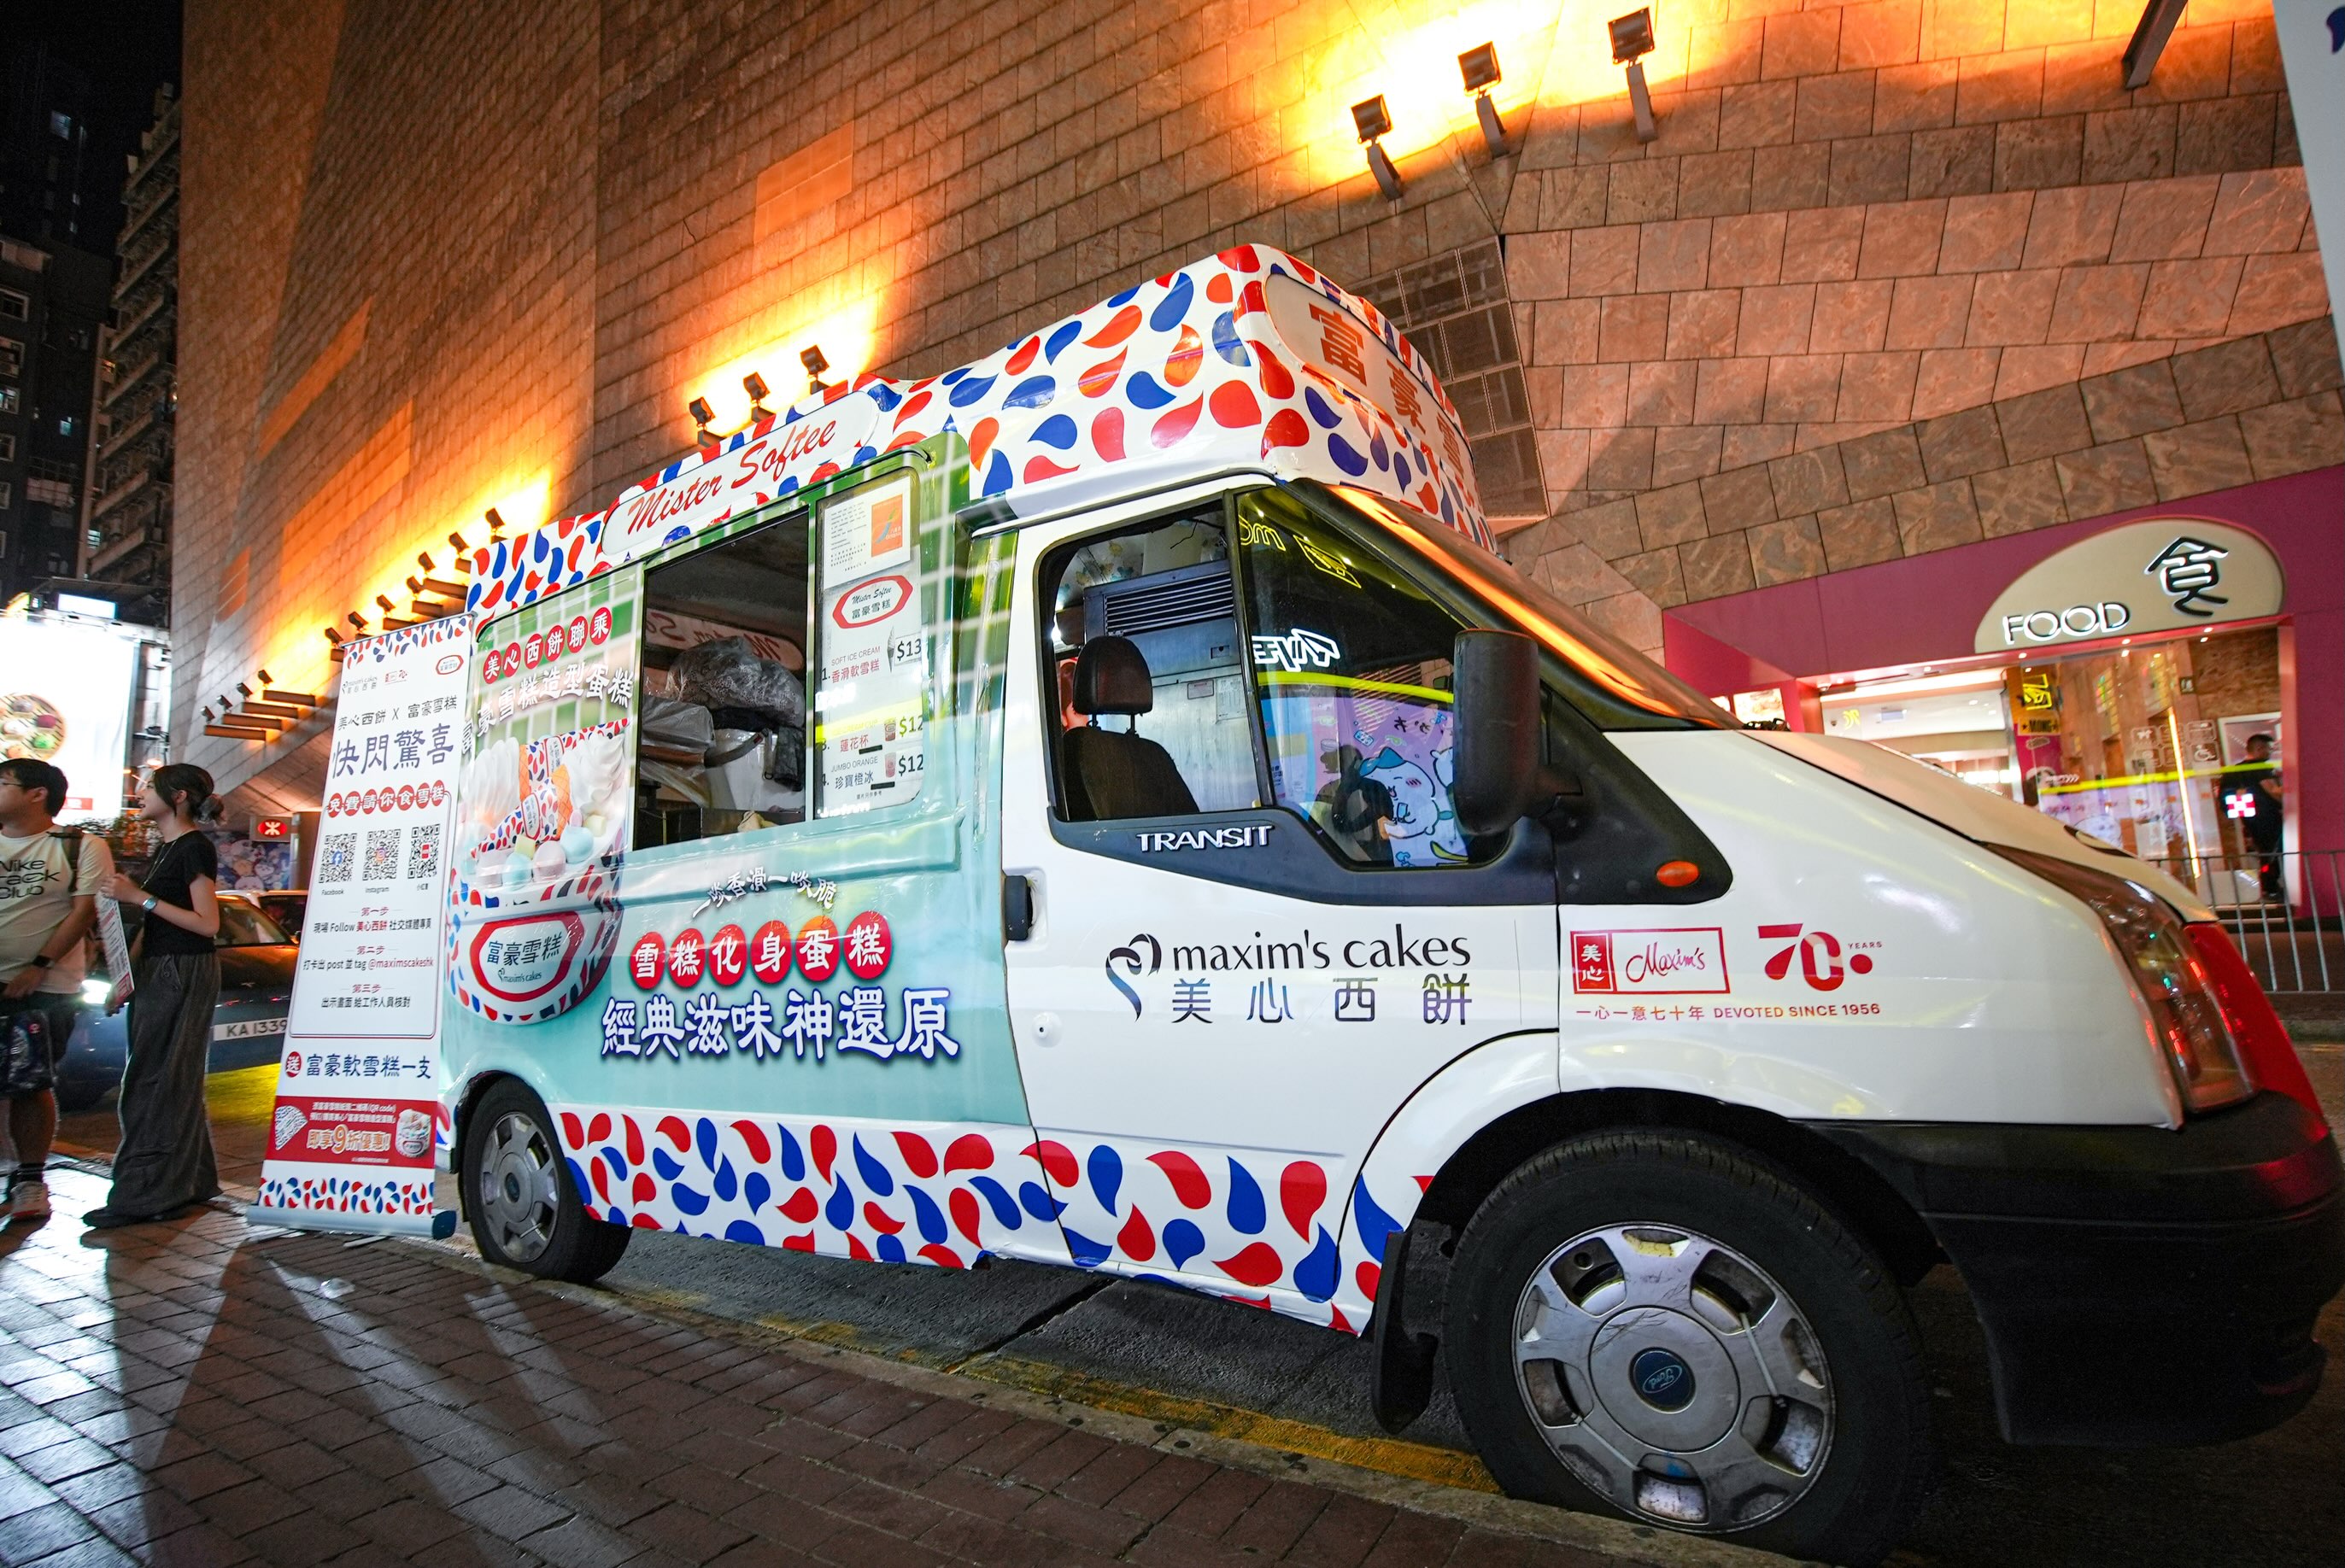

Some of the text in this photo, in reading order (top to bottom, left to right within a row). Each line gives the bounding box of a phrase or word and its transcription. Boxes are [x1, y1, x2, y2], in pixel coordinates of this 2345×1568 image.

[627, 420, 836, 535] Mister Softee
[2143, 536, 2228, 617] 食
[852, 587, 892, 605] Mister Softee
[852, 599, 891, 619] 富豪雪糕
[2002, 601, 2130, 645] FOOD
[484, 609, 611, 682] 美心西餅聯乘
[831, 646, 880, 666] SOFT ICE CREAM
[897, 638, 921, 661] $13
[831, 658, 880, 683] 香滑軟雪糕
[338, 709, 386, 730] 美心西餅
[407, 695, 458, 718] 富豪雪糕
[900, 715, 923, 737] $12
[332, 723, 454, 779] 快閃驚喜
[841, 734, 869, 752] 蓮花杯
[831, 757, 878, 773] JUMBO ORANGE
[898, 754, 923, 776] $12
[835, 770, 874, 789] 珍寶橙冰
[328, 783, 445, 814] 免費請你食雪糕
[1135, 824, 1275, 853] TRANSIT
[0, 860, 45, 872] Nike
[692, 867, 836, 918] 一啖香滑一啖脆
[361, 907, 389, 916] 第一步
[314, 922, 328, 933] 現場
[330, 922, 355, 932] Follow
[356, 921, 387, 932] 美心西餅
[356, 945, 384, 955] 第二步
[487, 932, 562, 965] 富豪雪糕
[632, 917, 889, 983] 雪糕化身蛋糕
[1173, 923, 1472, 971] maxim's cakes
[1757, 923, 1883, 992] 70 YEARS
[303, 960, 325, 970] 打卡出
[326, 961, 343, 971] post
[355, 960, 367, 971] tag
[368, 957, 434, 970] @maximscakeshk
[1580, 944, 1605, 982] 美心
[1626, 942, 1708, 983] Maxim's
[525, 971, 542, 980] cakes
[353, 984, 381, 993] 第三步
[1171, 973, 1473, 1026] 美心西餅
[601, 986, 959, 1060] 經典滋味神還原
[1576, 1003, 1880, 1021] 一心一意七十年 DEVOTED SINCE 1956
[285, 1054, 431, 1079] 送 富豪軟雪糕一支
